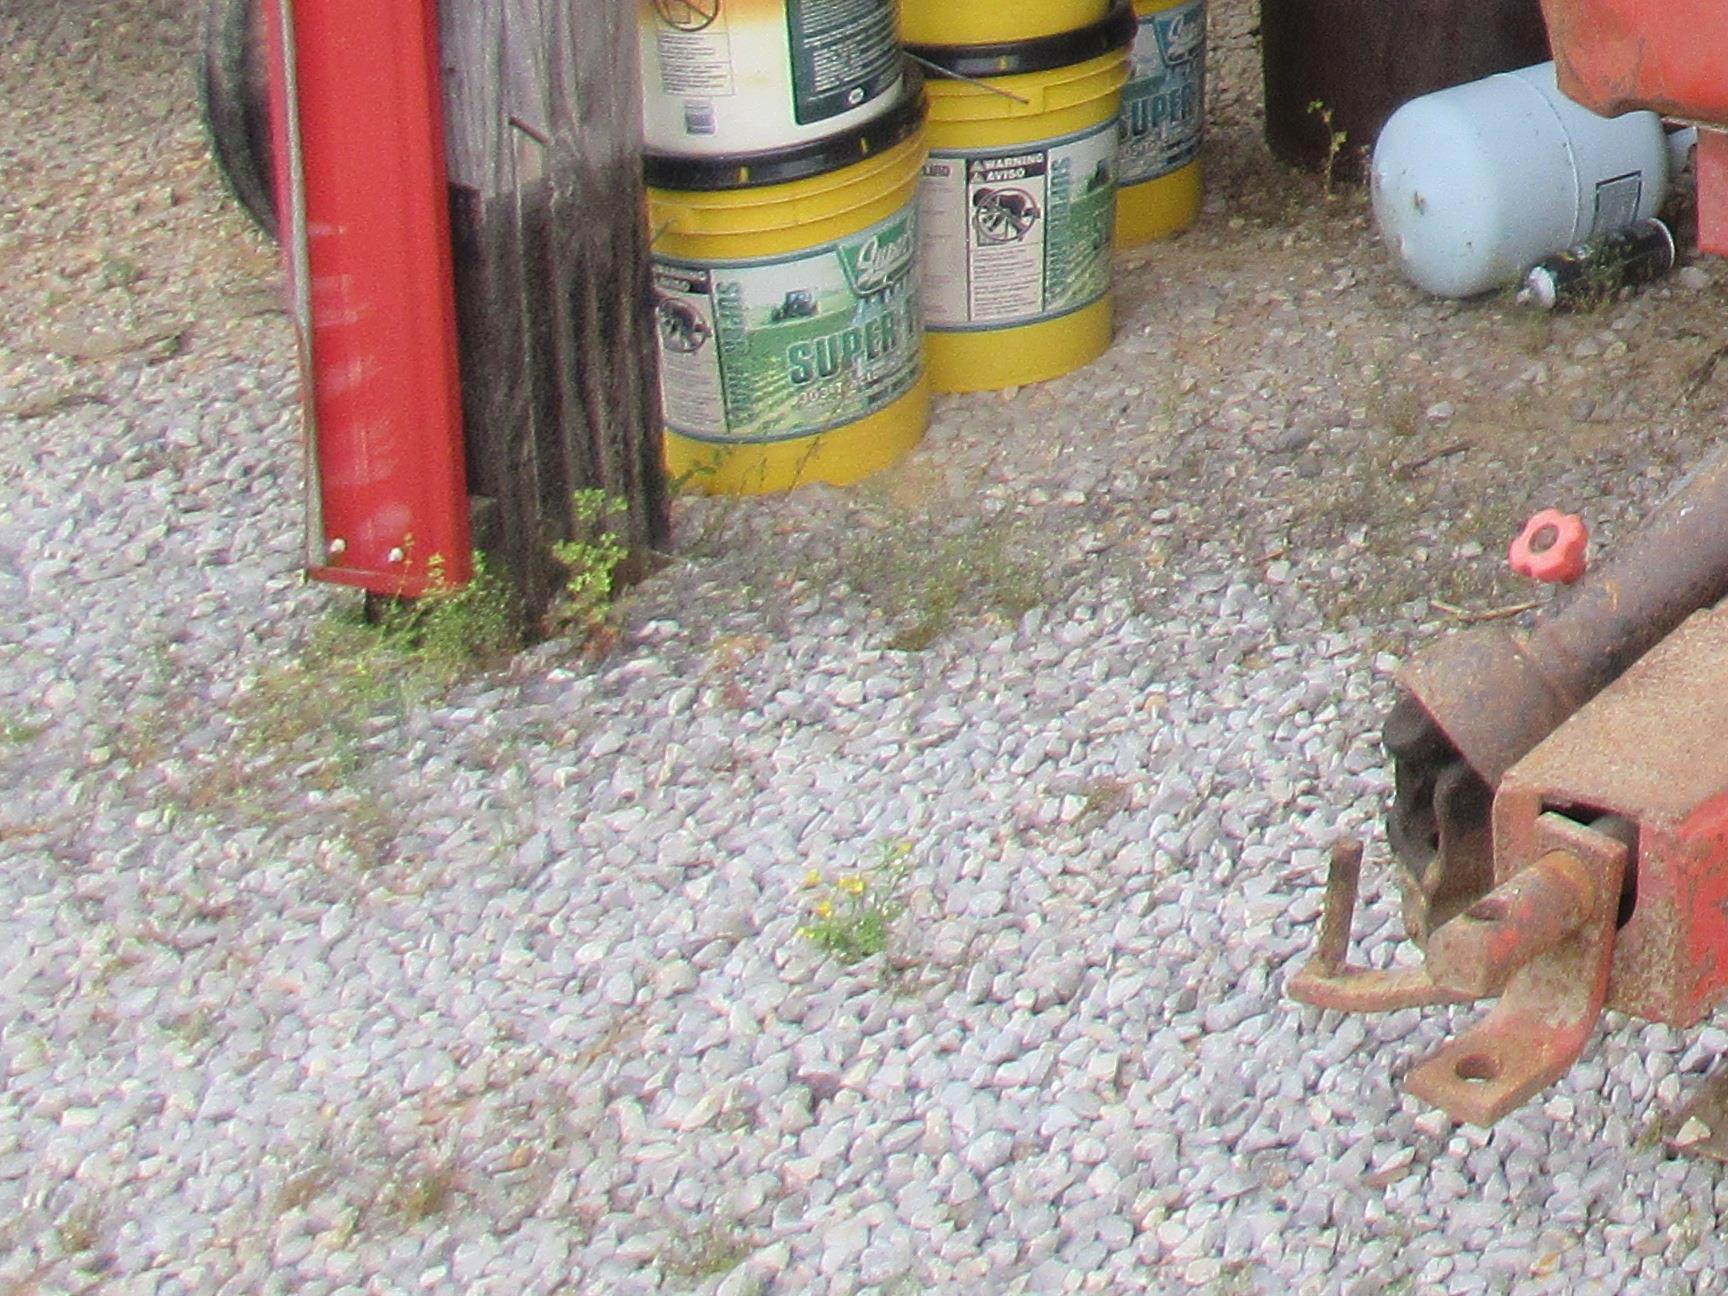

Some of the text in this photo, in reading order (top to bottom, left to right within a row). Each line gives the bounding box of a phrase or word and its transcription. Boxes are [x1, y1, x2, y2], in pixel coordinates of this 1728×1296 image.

[985, 153, 1044, 170] WARNING
[985, 168, 1025, 182] AVISO
[786, 307, 897, 386] SUPER
